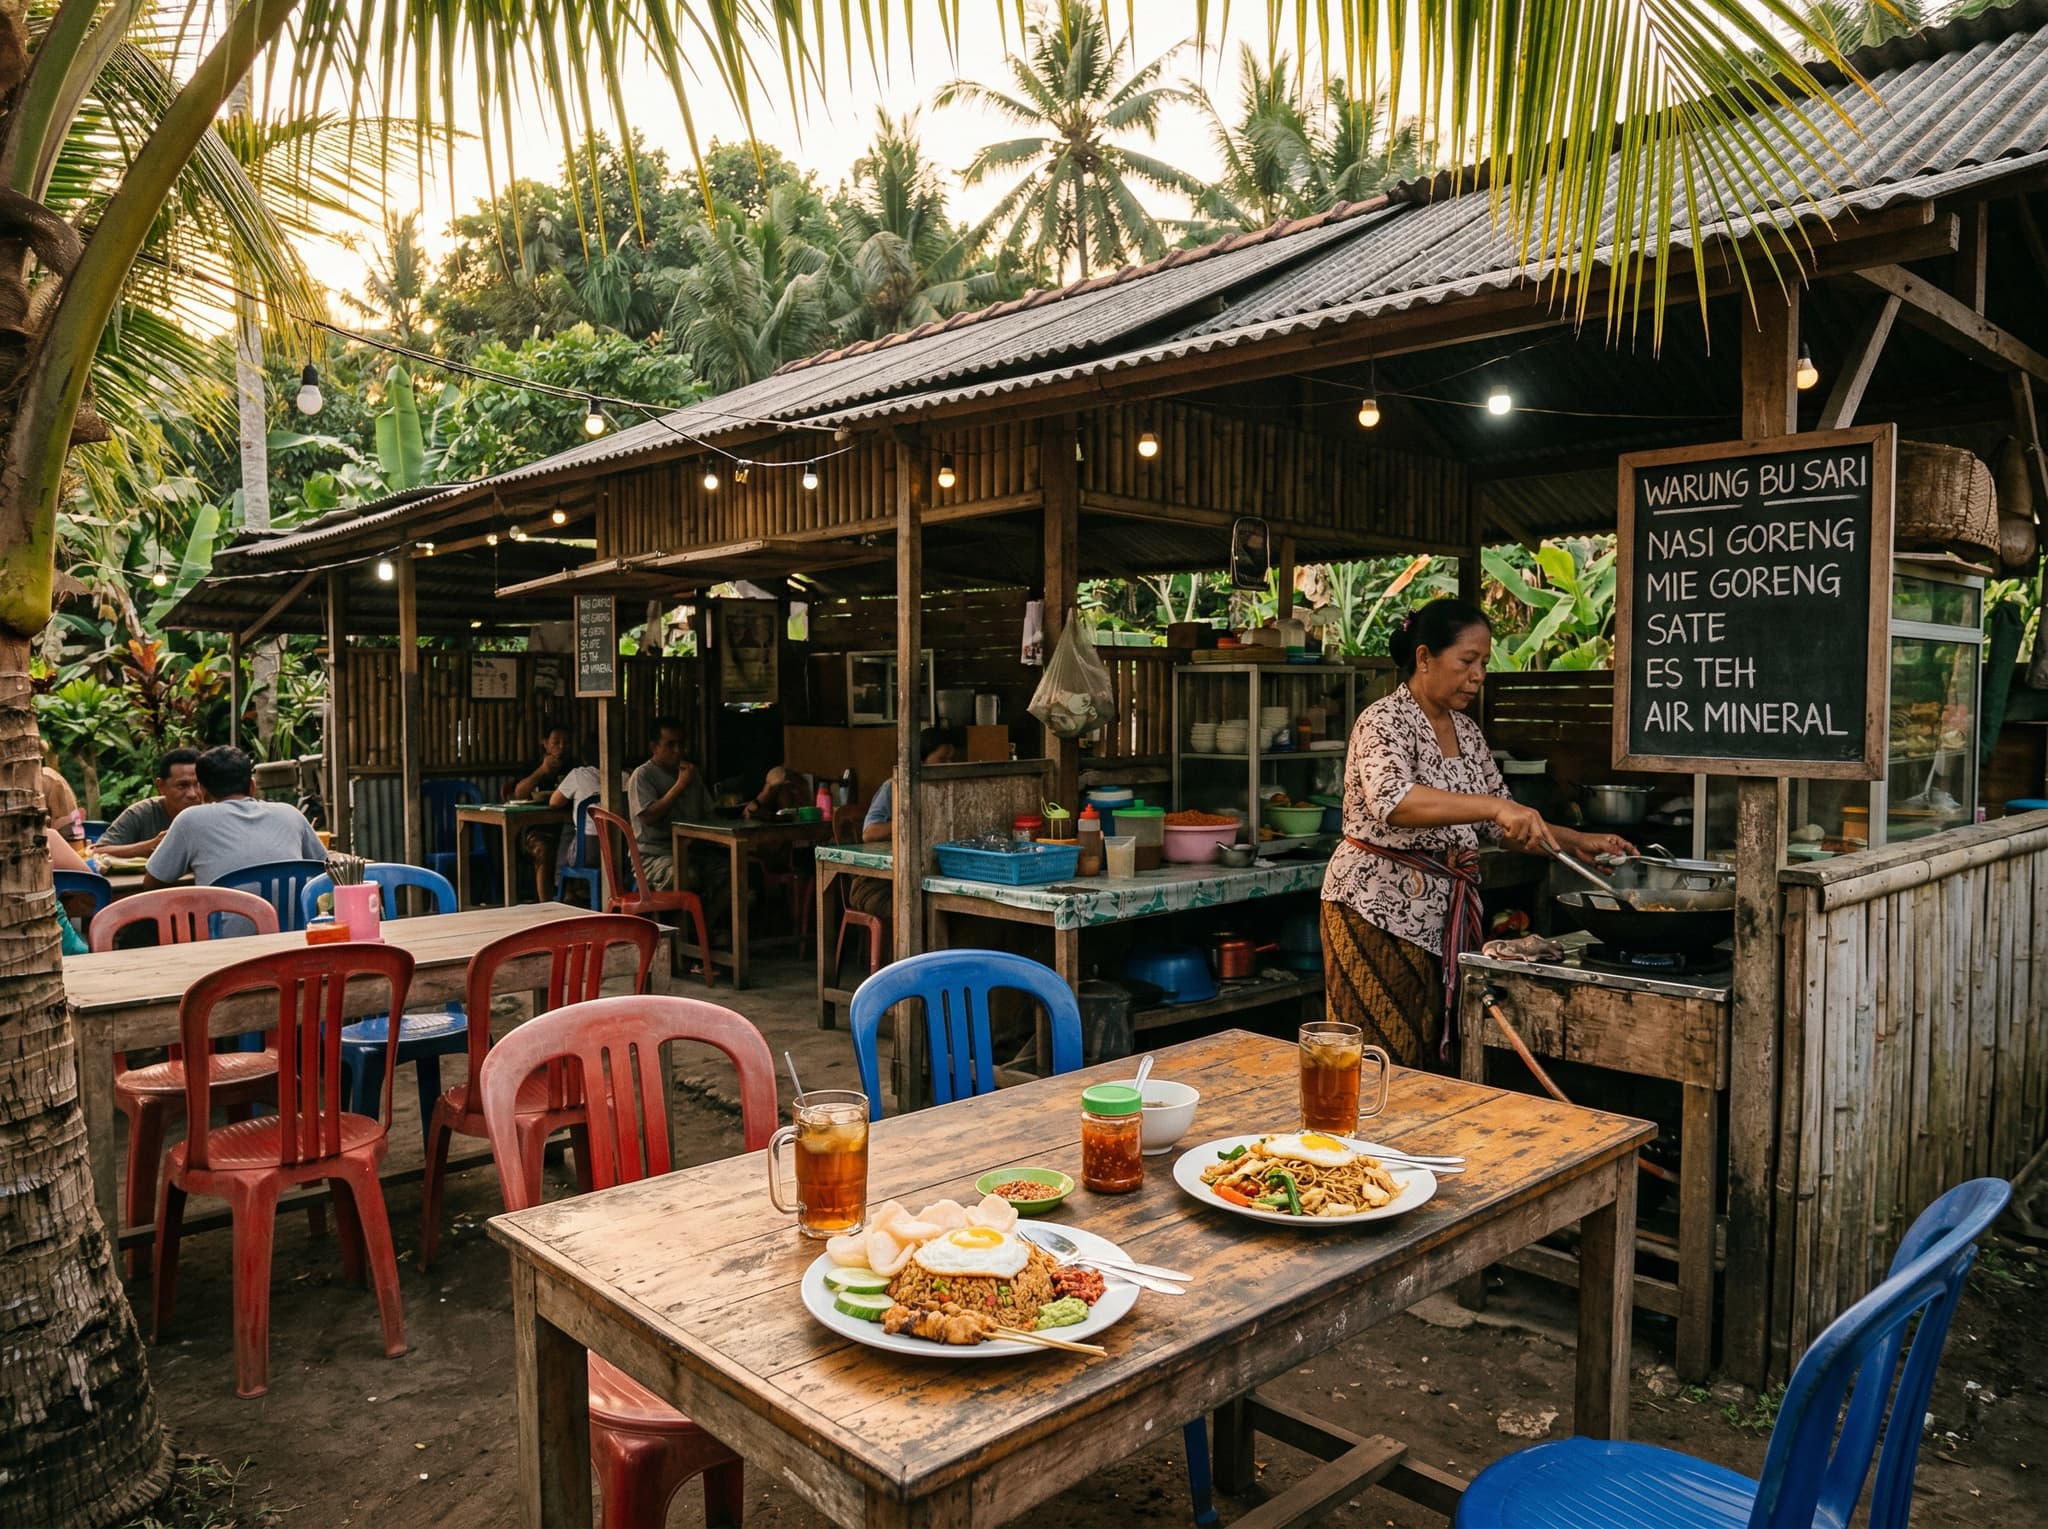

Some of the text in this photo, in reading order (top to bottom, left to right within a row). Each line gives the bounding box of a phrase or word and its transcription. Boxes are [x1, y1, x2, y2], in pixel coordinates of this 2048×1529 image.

[1644, 456, 1867, 507] WARUNG BU SARI
[1648, 518, 1855, 561] NASI GORENG
[1647, 563, 1841, 603] MIE GORENG
[1647, 613, 1726, 646] SATE
[1647, 657, 1756, 689] ES TEH
[1644, 701, 1849, 736] AIR MINERAL
